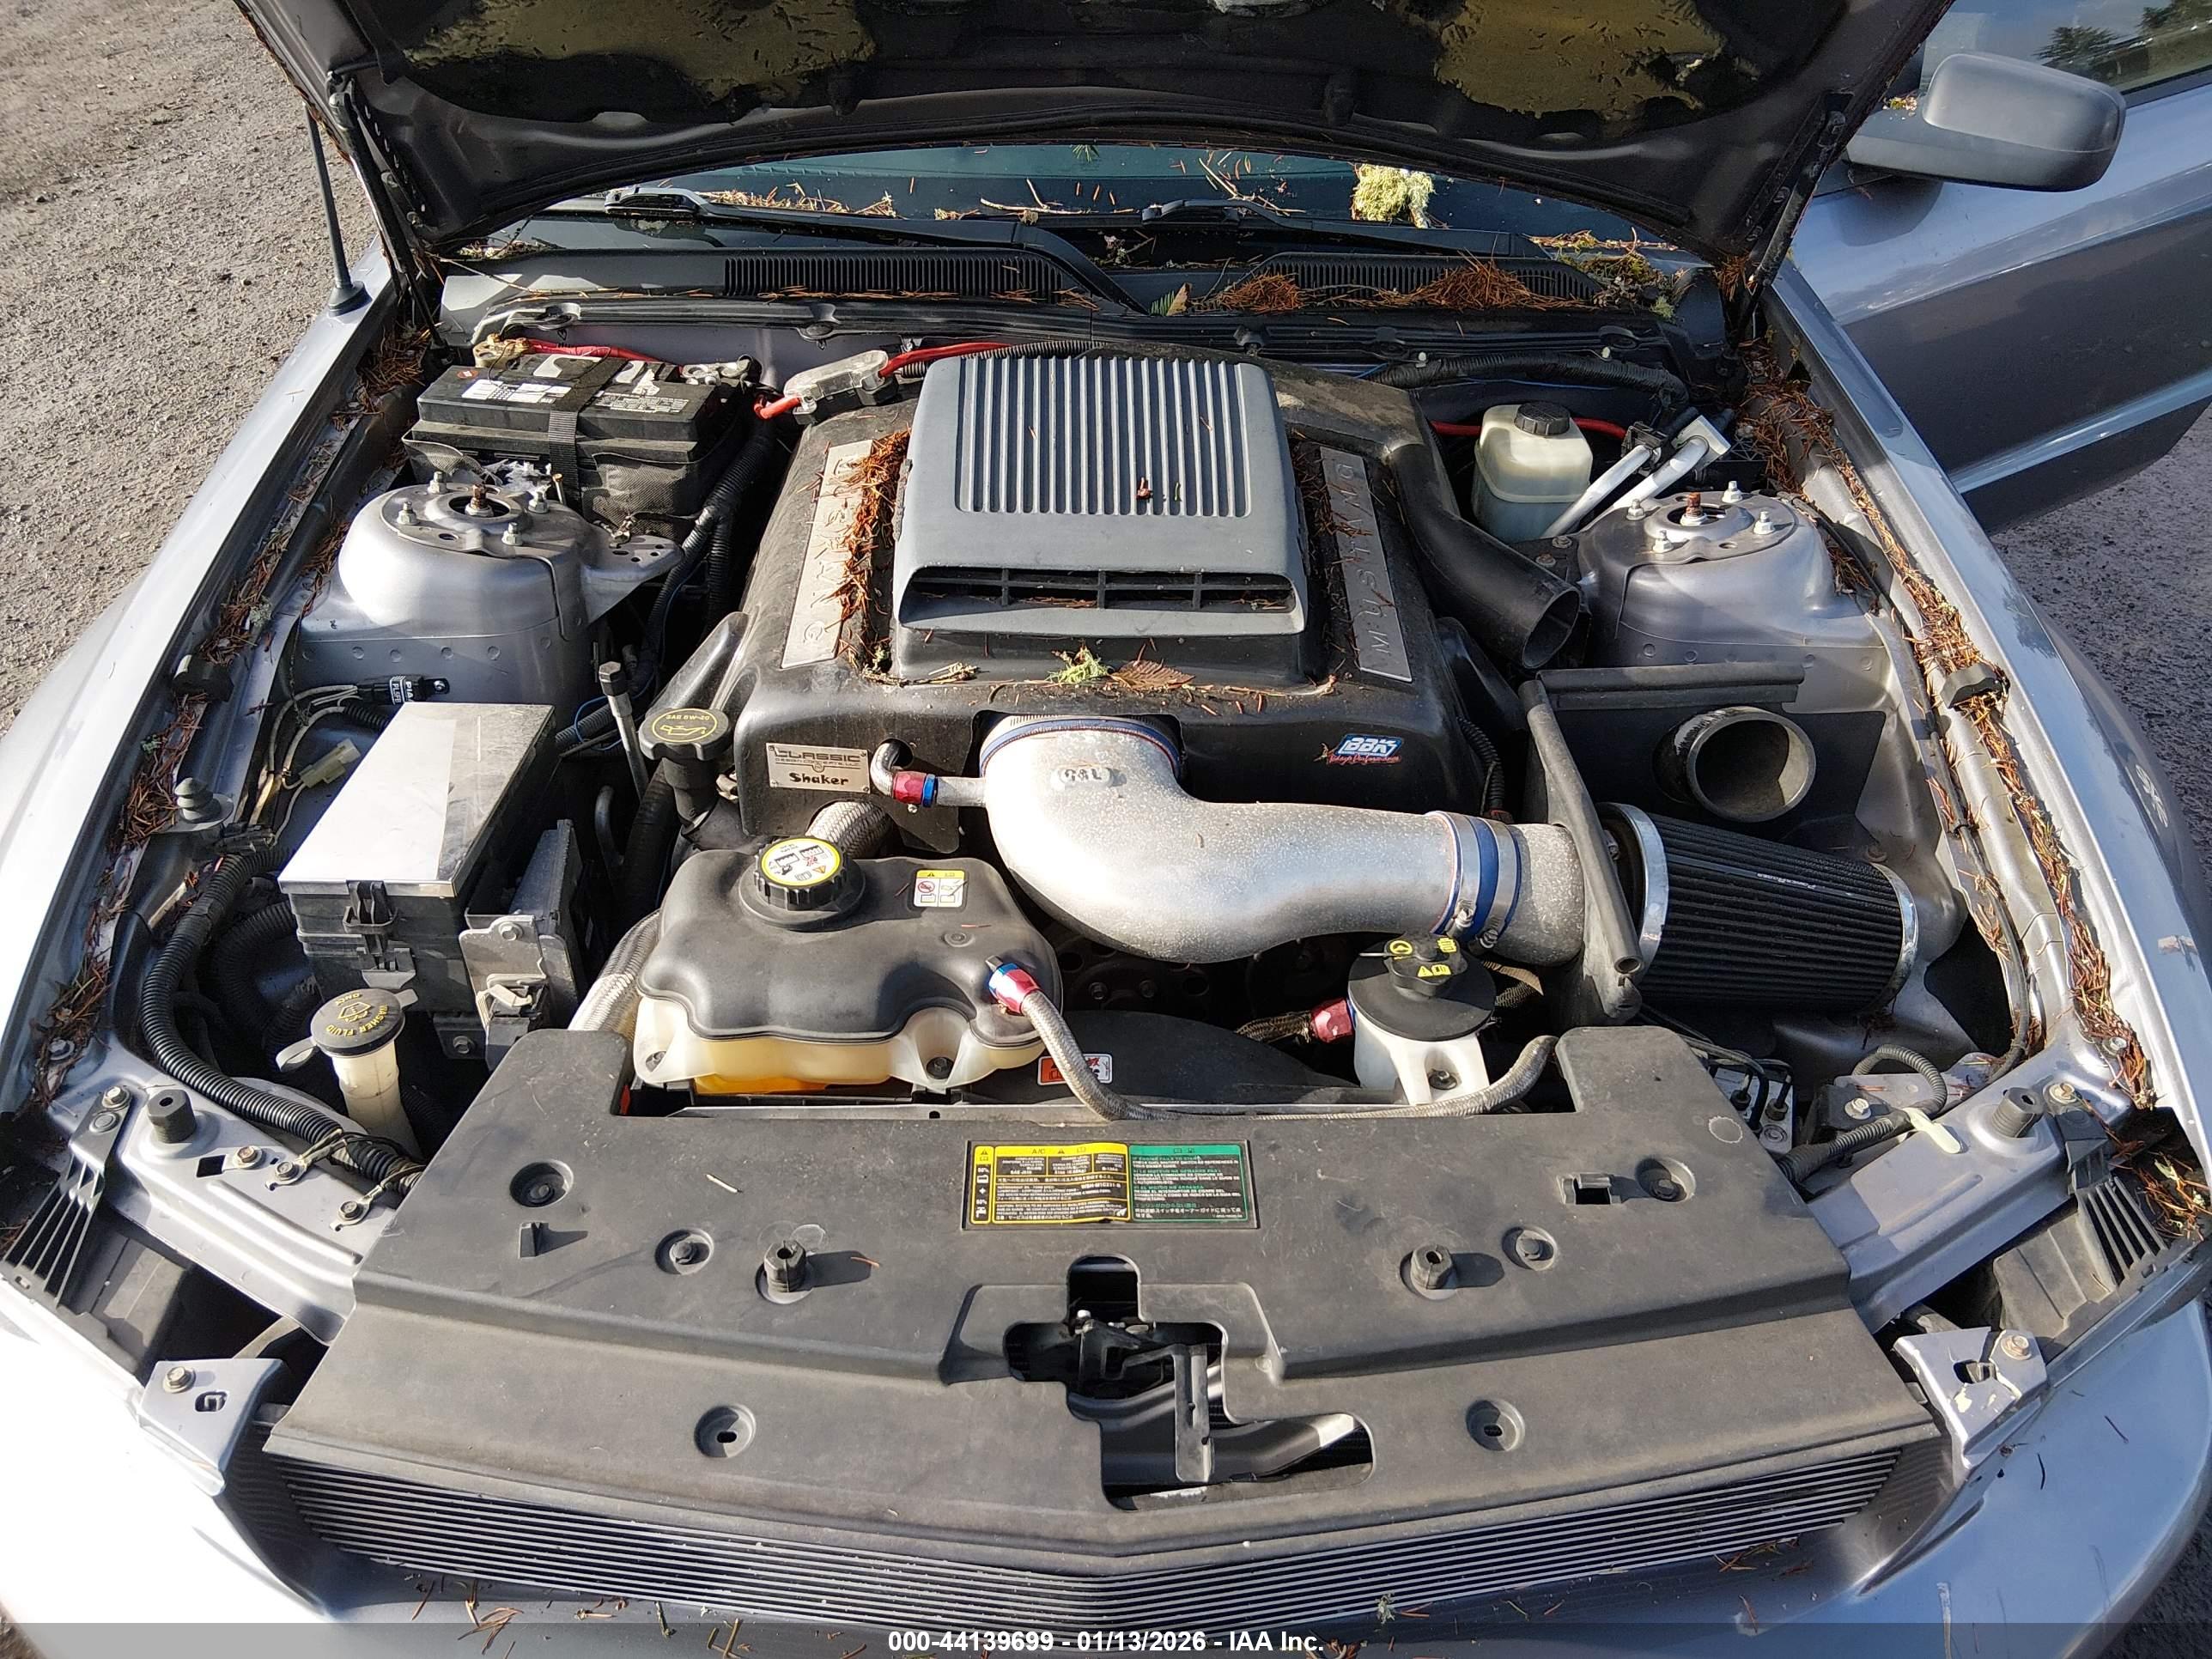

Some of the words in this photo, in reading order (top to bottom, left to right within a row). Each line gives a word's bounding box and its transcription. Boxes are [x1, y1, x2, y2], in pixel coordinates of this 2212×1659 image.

[1344, 737, 1397, 753] BBK
[775, 748, 860, 763] CLASSIC
[788, 772, 848, 786] Shaker
[359, 1005, 388, 1033] WASHER
[326, 1024, 354, 1036] FLUID
